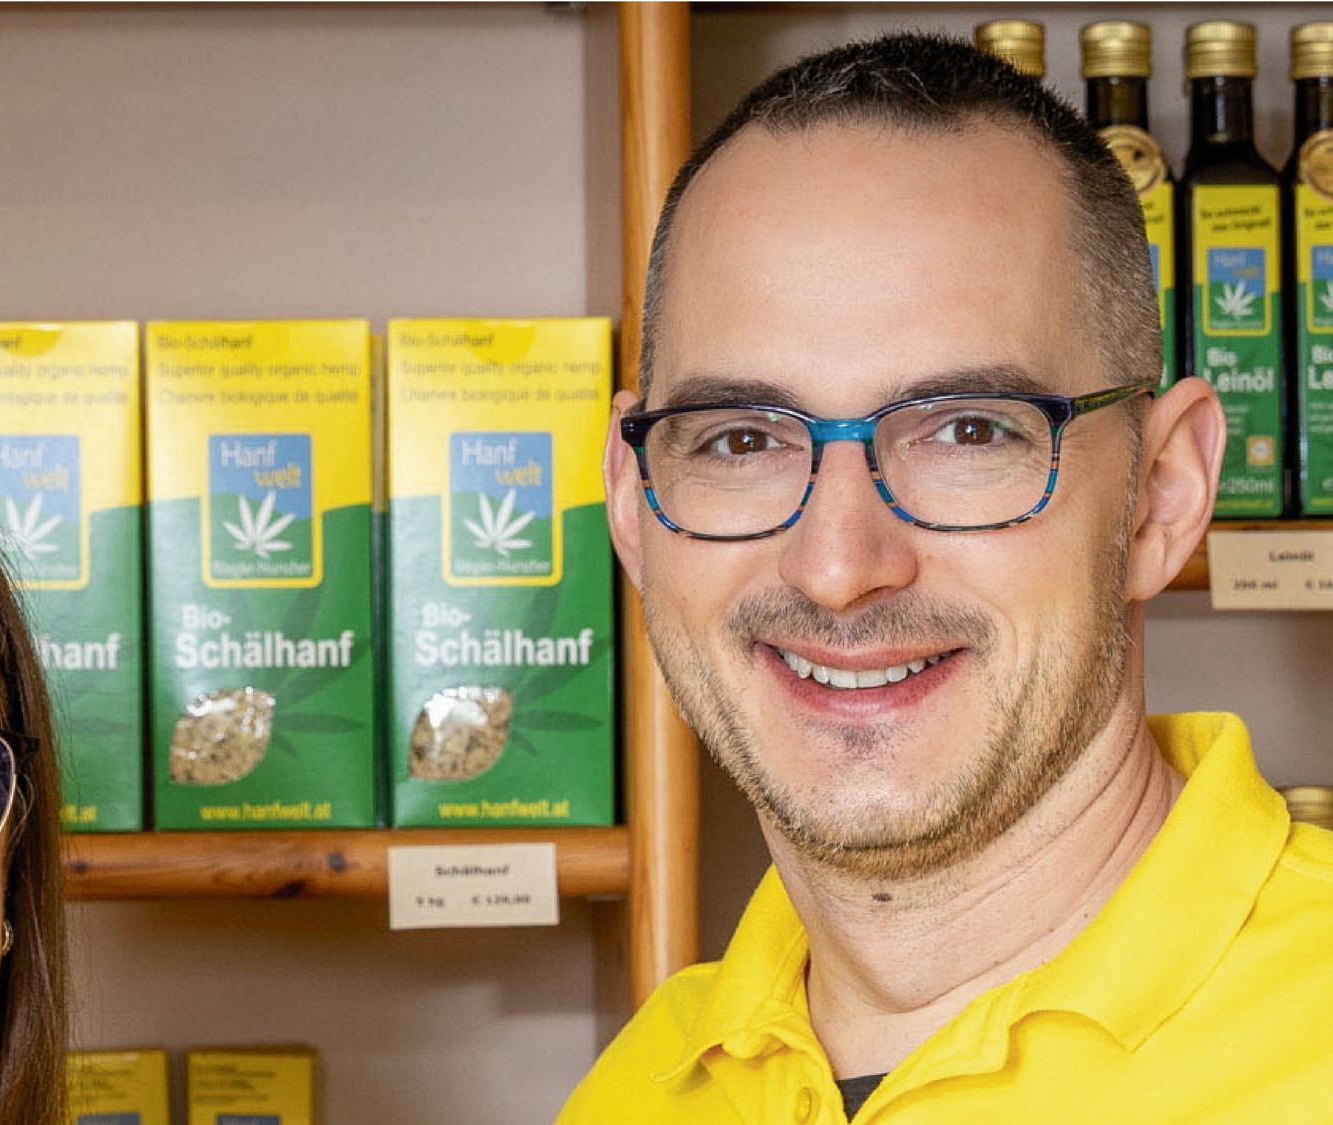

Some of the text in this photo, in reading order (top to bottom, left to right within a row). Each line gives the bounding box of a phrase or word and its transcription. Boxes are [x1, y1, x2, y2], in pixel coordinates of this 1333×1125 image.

[1206, 347, 1238, 368] Bio
[220, 440, 278, 468] Hanf
[461, 438, 518, 467] Hanf
[22, 464, 70, 491] welt
[253, 461, 301, 488] welt
[495, 460, 542, 487] welt
[181, 603, 232, 630] Bio-
[421, 601, 473, 628] Bio-
[175, 629, 355, 669] Schälhanf
[414, 627, 595, 667] Schälhanf
